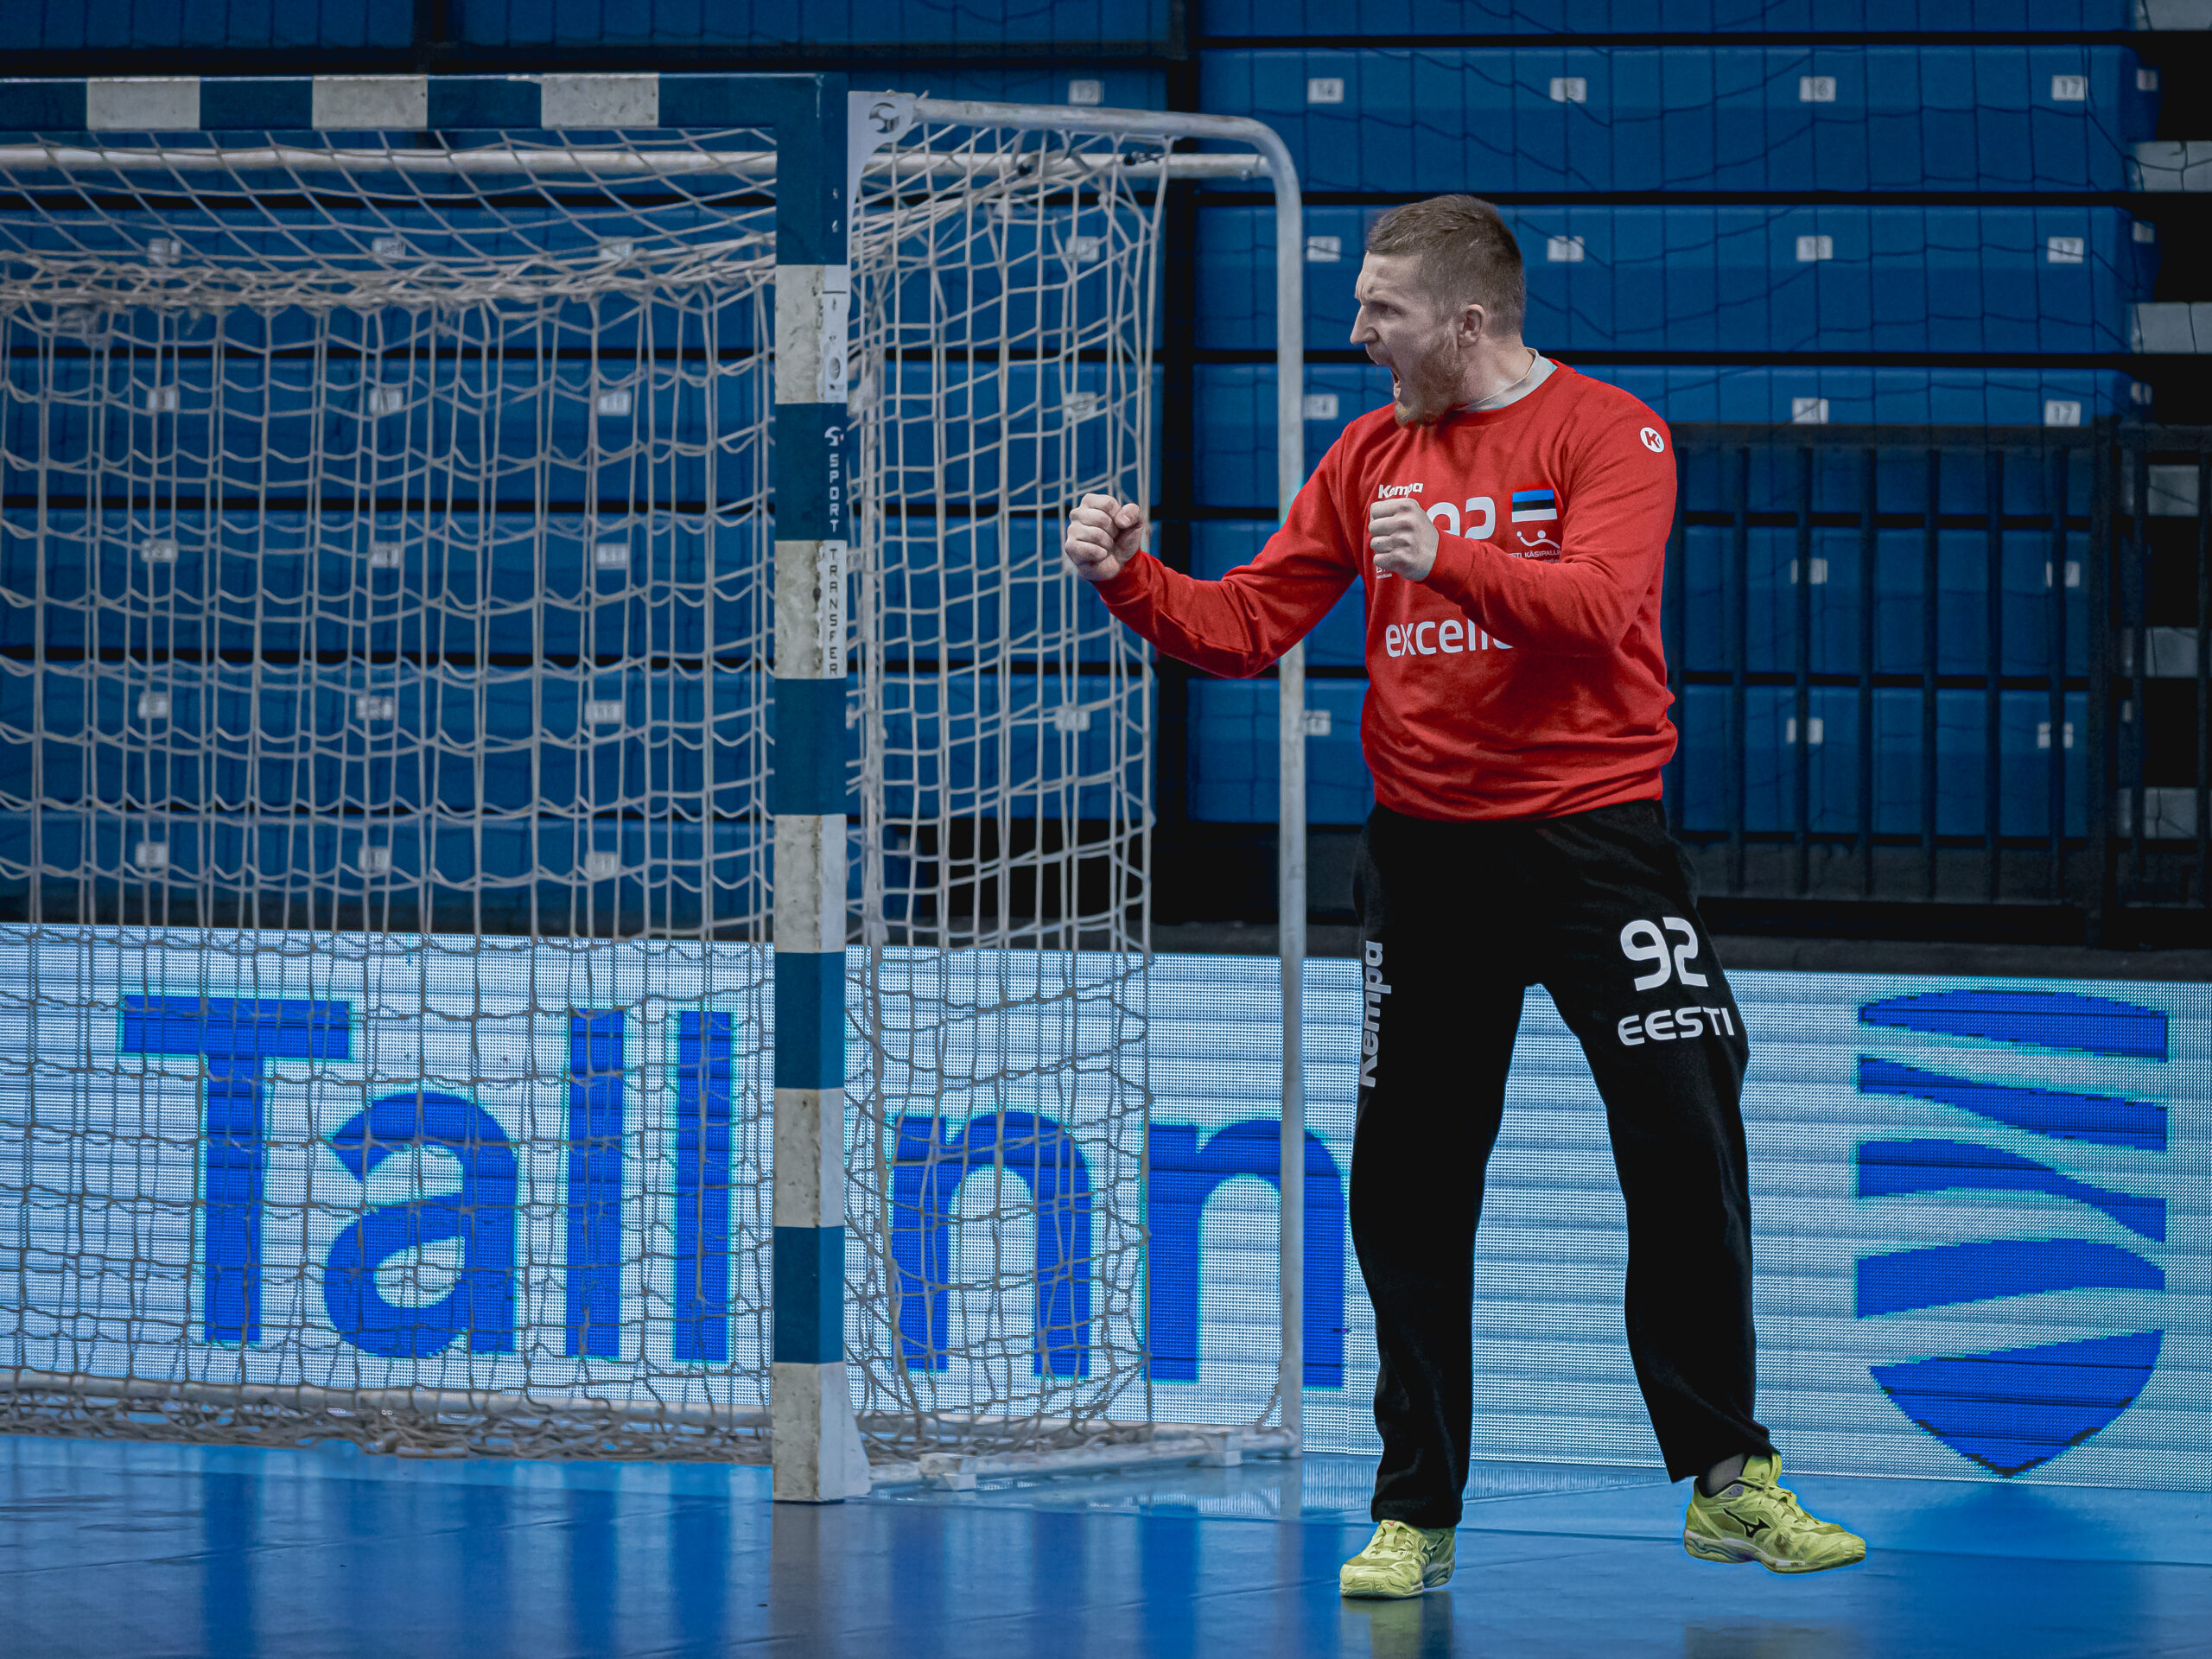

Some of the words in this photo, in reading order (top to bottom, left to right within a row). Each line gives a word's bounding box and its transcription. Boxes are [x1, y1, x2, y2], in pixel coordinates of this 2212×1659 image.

[829, 453, 839, 533] SPORT
[1377, 482, 1424, 499] Kempa
[829, 548, 838, 676] TRANSFER
[1385, 618, 1514, 658] excell
[1620, 917, 1708, 992] 92
[1359, 940, 1392, 1088] Kempa
[1618, 1006, 1735, 1046] EESTI
[120, 994, 1344, 1389] Tallnn
